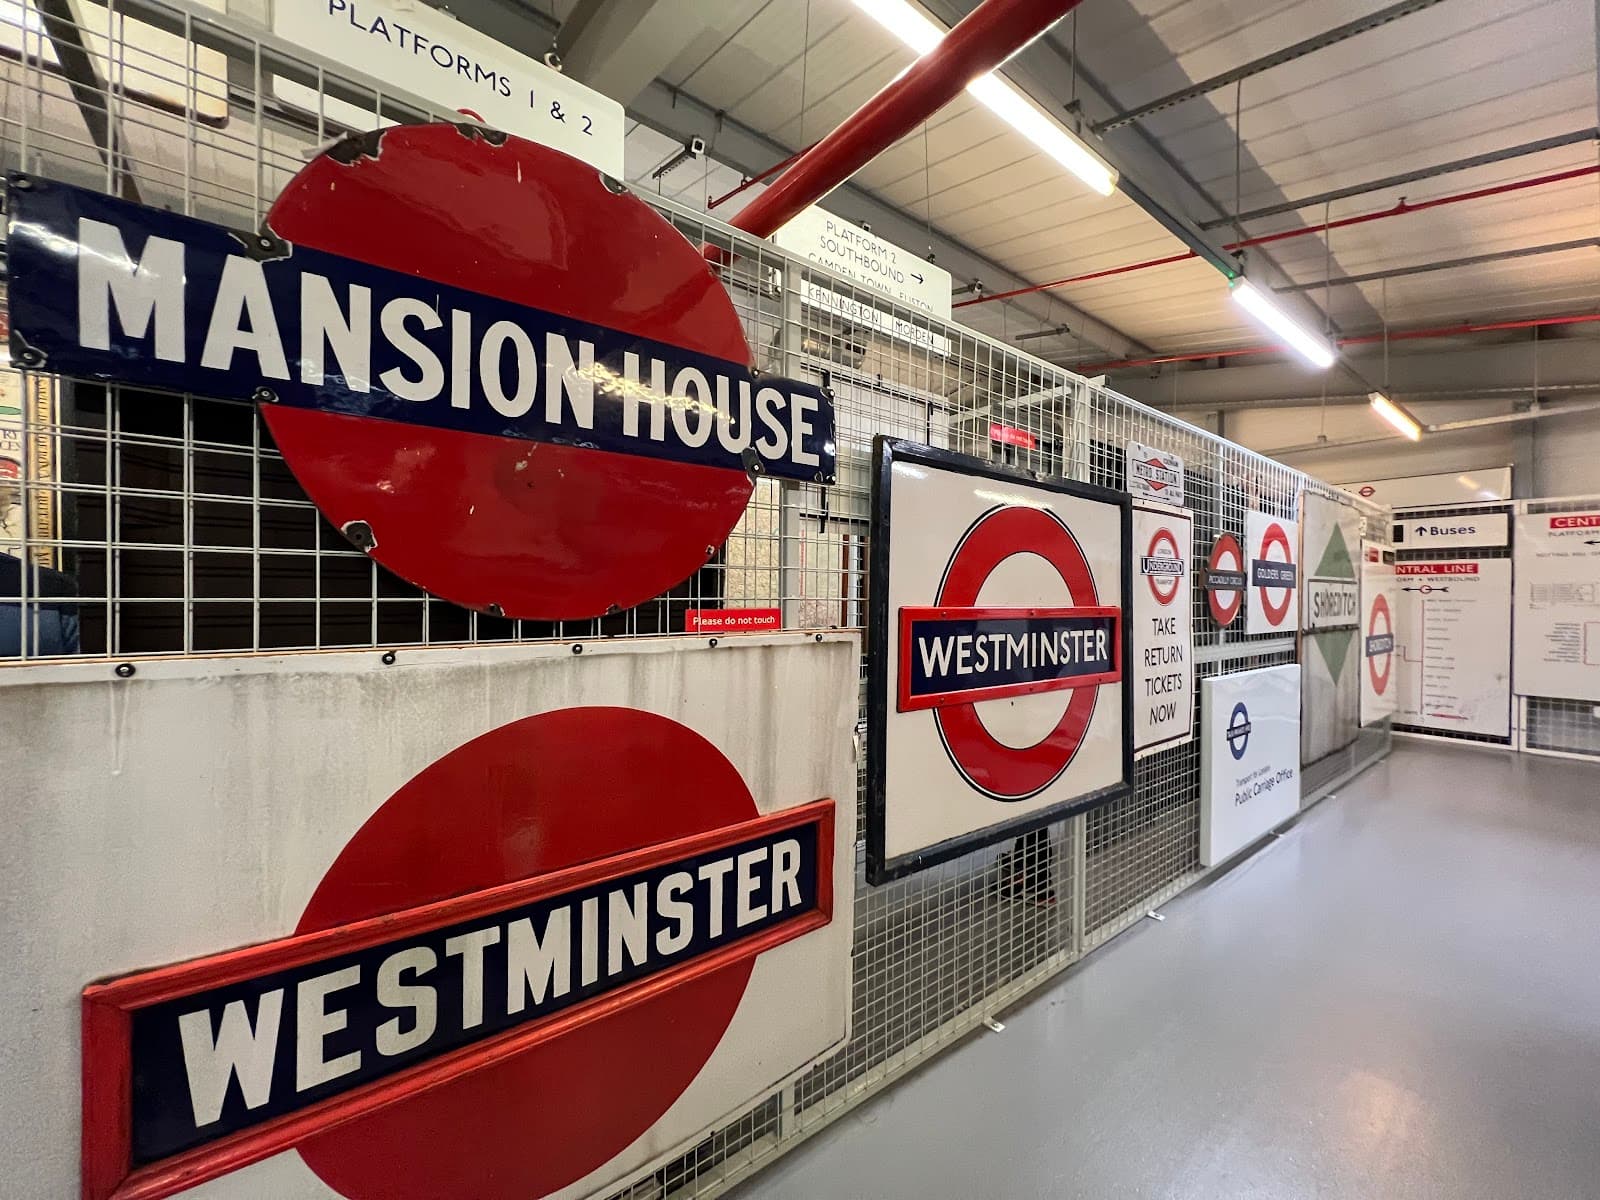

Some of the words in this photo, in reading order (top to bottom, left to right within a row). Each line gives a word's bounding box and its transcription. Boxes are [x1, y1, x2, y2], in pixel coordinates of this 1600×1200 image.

[328, 0, 512, 97] PLATFORMS
[549, 101, 567, 124] &
[581, 115, 594, 136] 2
[826, 220, 887, 260] PLATFORM
[890, 251, 897, 265] 2
[819, 235, 905, 284] SOUTHBOUND
[808, 286, 879, 323] KENNINGTON
[895, 319, 934, 345] MORDEN
[77, 216, 596, 430] MANSION
[622, 352, 820, 467] HOUSE
[1430, 525, 1476, 536] Buses
[1142, 557, 1184, 575] UNDERGROUND
[1443, 564, 1474, 573] LINE
[1313, 591, 1357, 618] SHOREDITCH
[692, 616, 723, 626] Please
[724, 615, 736, 625] do
[737, 616, 753, 625] not
[753, 615, 776, 624] touch
[1151, 617, 1176, 636] TAKE
[918, 629, 1108, 678] WESTMINSTER
[1144, 645, 1183, 667] RETURN
[1144, 673, 1182, 697] TICKETS
[1149, 702, 1177, 726] NOW
[1234, 788, 1252, 807] Public
[1253, 777, 1275, 797] Carriage
[1275, 768, 1294, 784] Office
[178, 838, 802, 1128] WESTMINSTER
